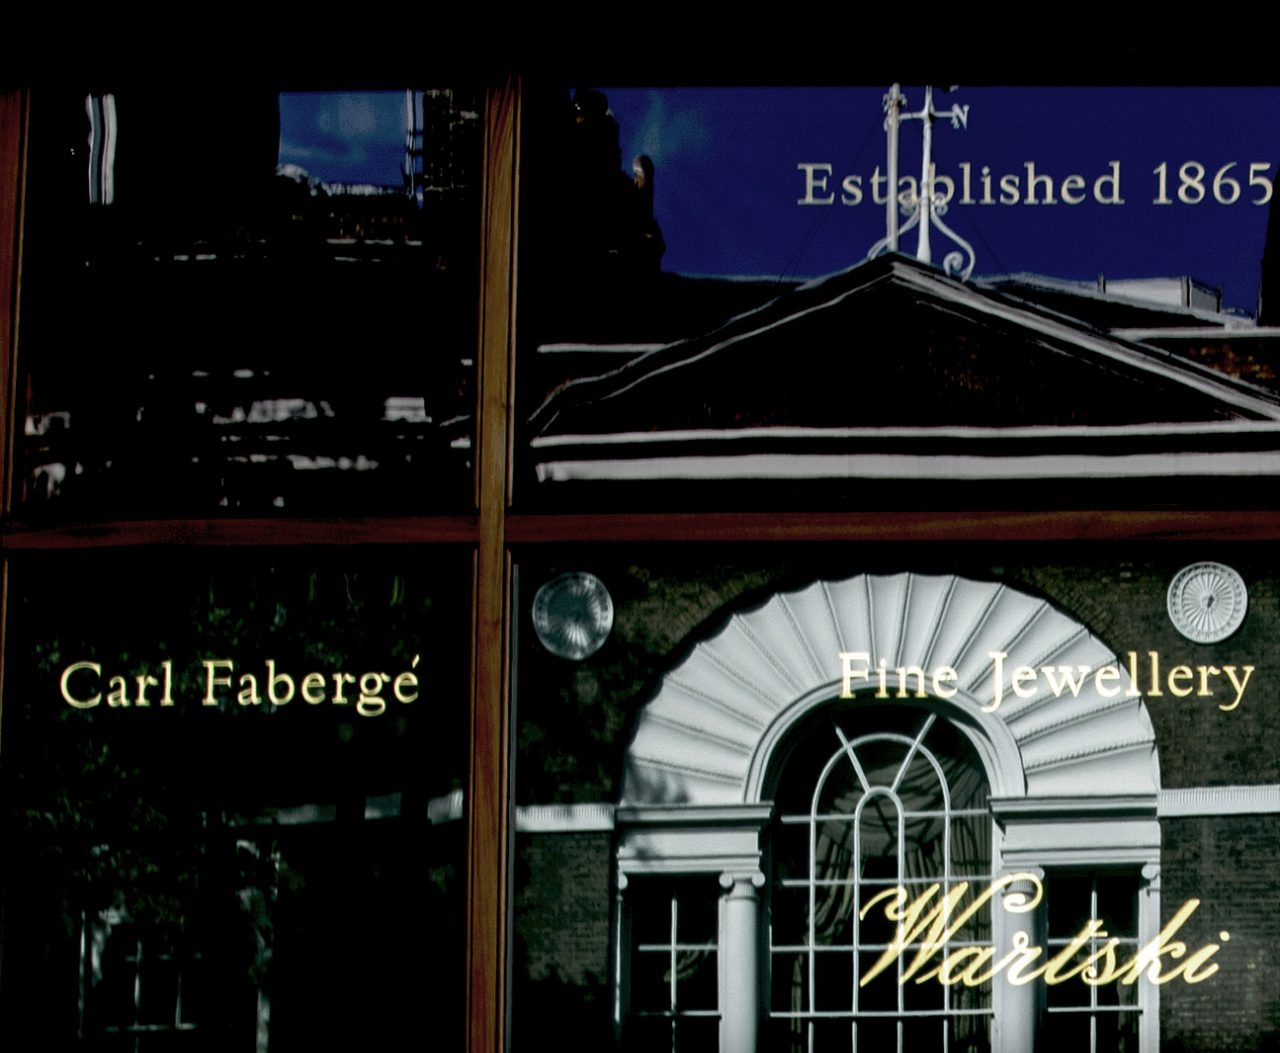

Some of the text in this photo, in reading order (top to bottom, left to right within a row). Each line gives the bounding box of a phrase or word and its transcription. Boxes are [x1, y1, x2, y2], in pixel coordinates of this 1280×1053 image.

[797, 160, 1275, 206] Established 1865
[60, 653, 420, 717] Carl Fabergé
[838, 650, 1256, 713] Fine Jewellery
[859, 871, 1231, 988] Wartski
